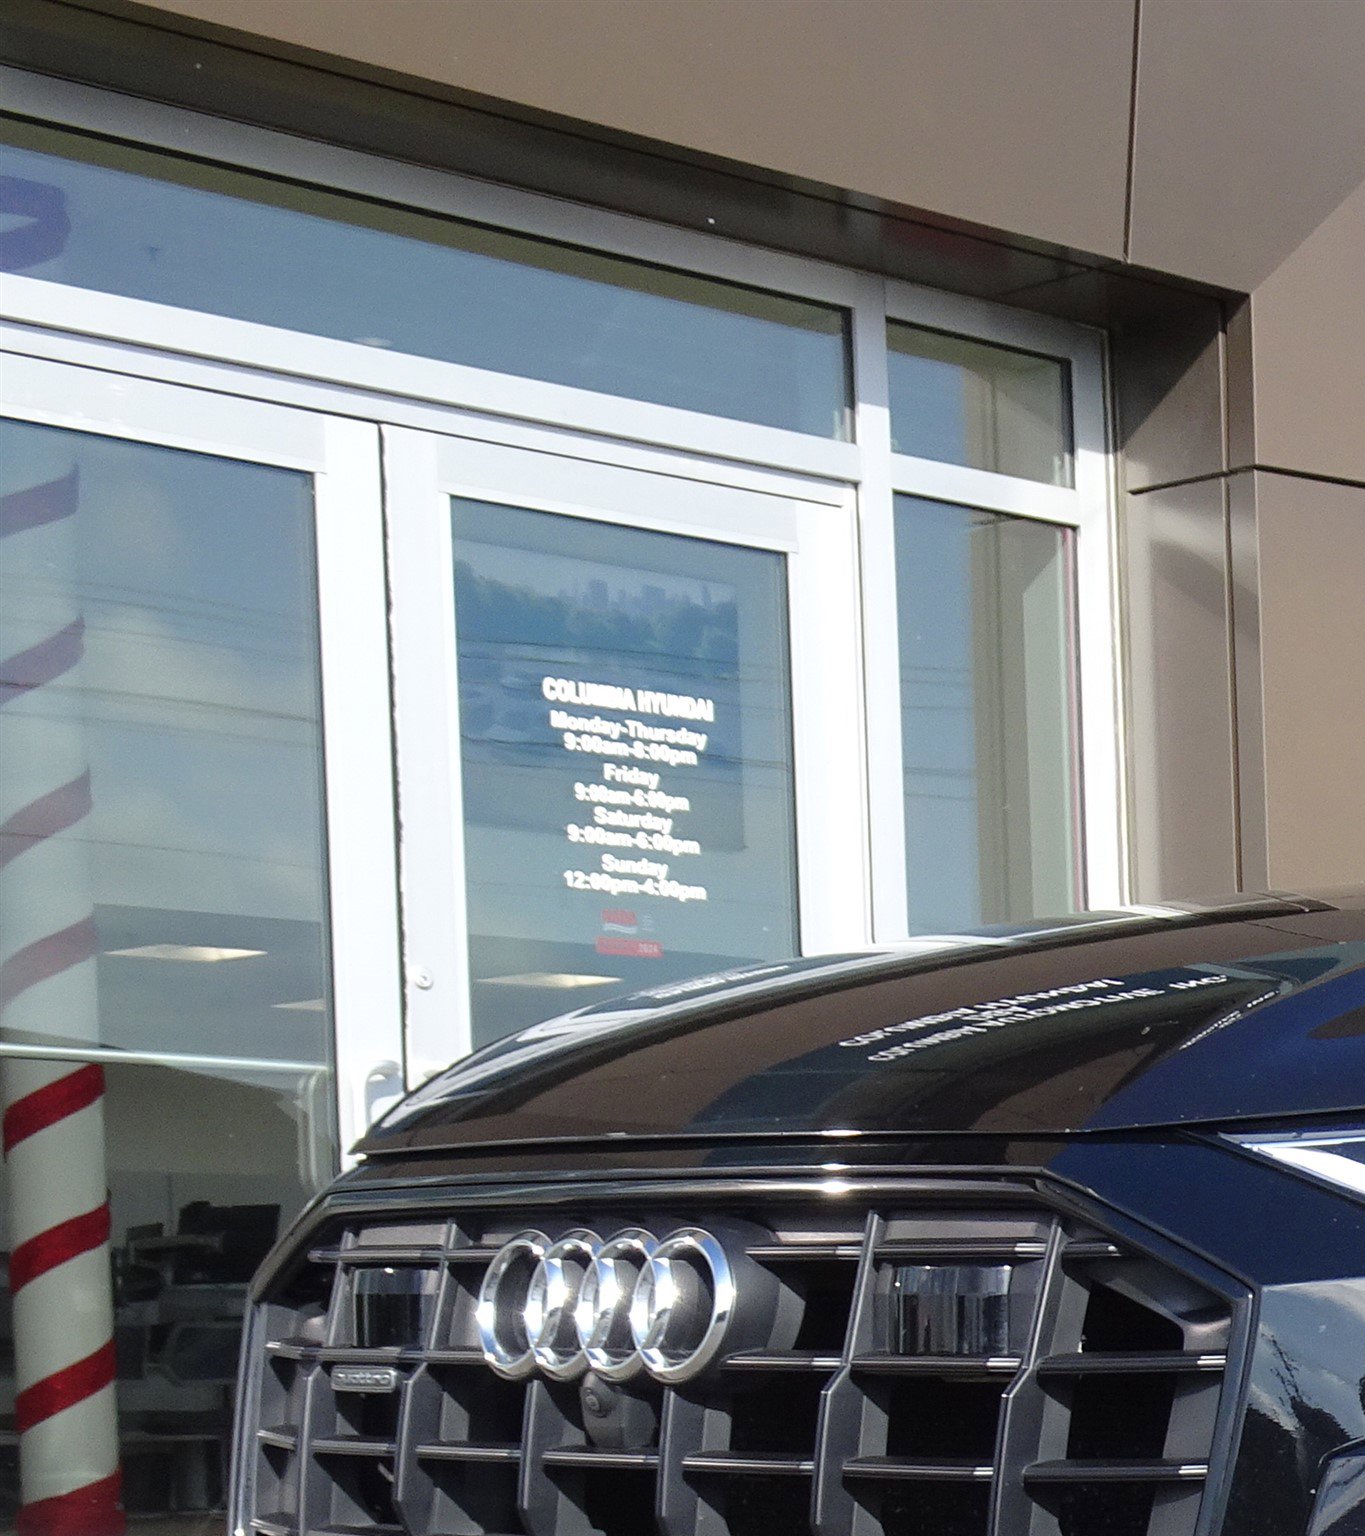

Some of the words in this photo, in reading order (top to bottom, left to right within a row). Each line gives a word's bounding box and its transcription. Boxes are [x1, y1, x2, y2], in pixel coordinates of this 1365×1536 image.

[543, 677, 636, 711] COLUMBIA
[638, 690, 714, 721] HYUNDAI
[550, 710, 707, 750] Monday-Thursday
[604, 763, 659, 789] Friday
[594, 806, 672, 834] Saturday
[601, 853, 668, 880] Sunday
[564, 870, 707, 902] 12:00pm-4:00pm
